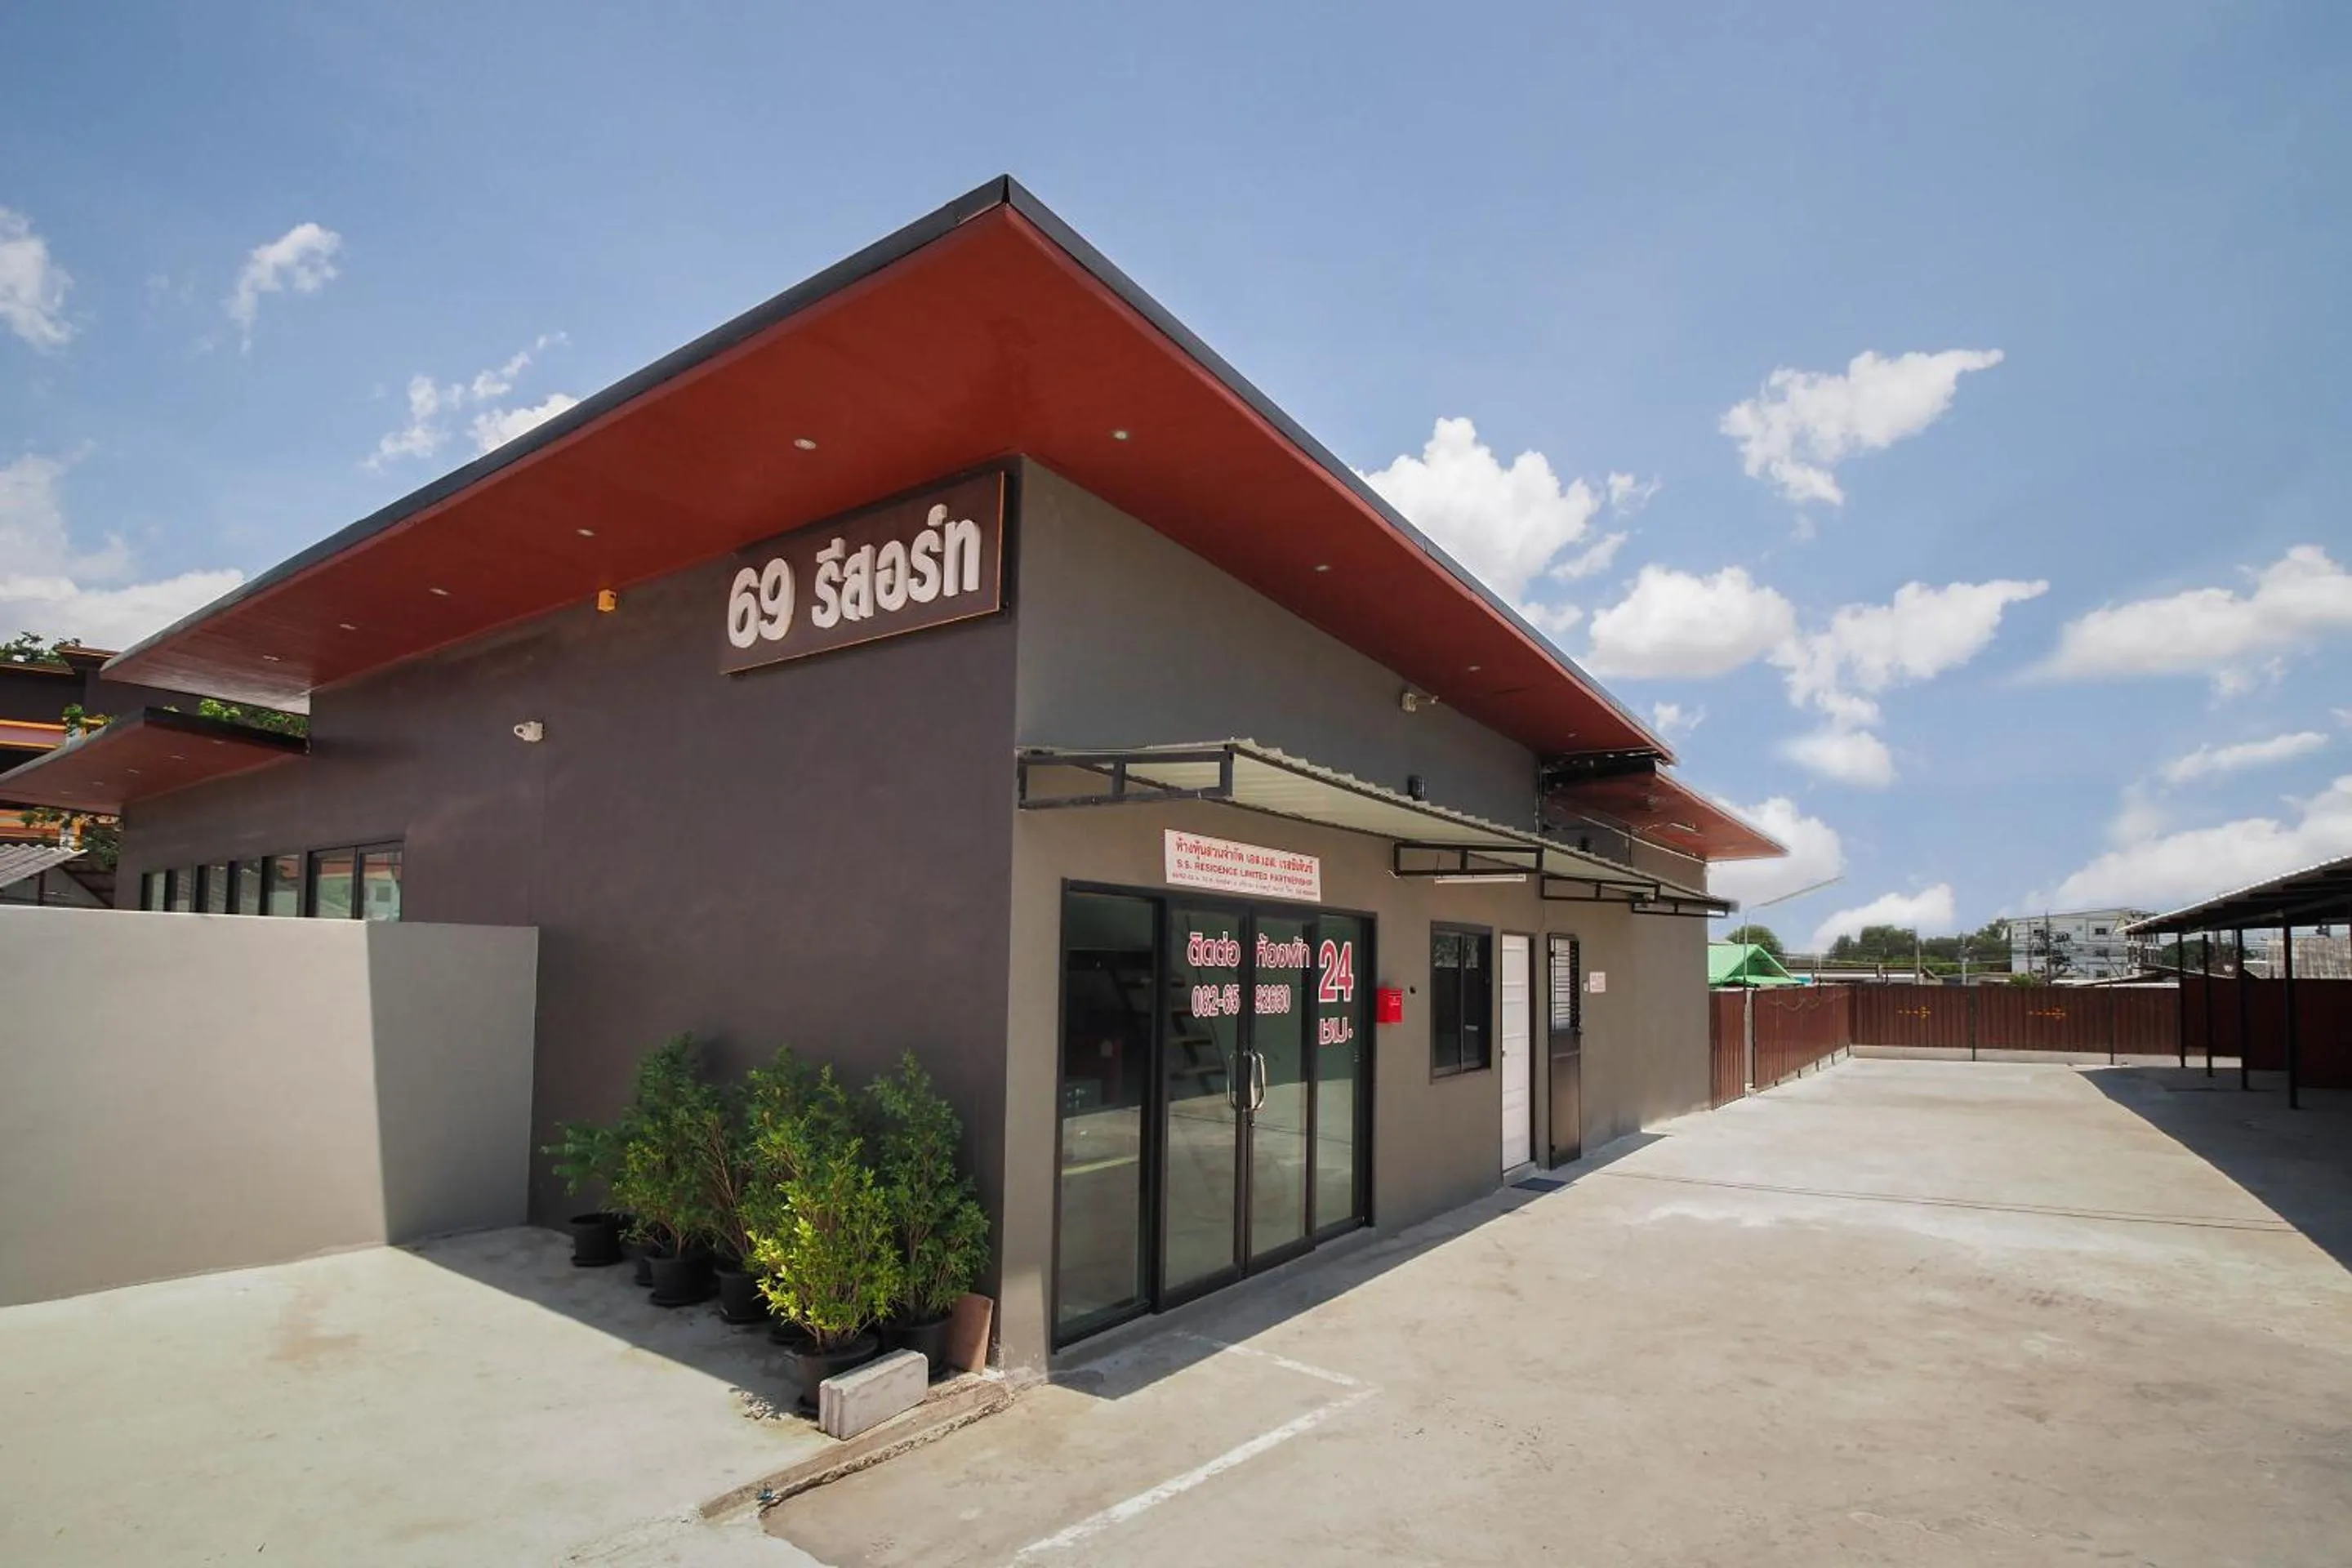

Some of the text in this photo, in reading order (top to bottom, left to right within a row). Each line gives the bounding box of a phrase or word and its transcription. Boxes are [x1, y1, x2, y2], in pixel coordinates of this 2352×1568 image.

[728, 503, 981, 648] 69 รีสอร์ท
[1194, 862, 1238, 876] RESIDENCE
[1240, 870, 1268, 880] LIMITED
[1269, 872, 1313, 886] PARTNERSHIP
[1187, 931, 1311, 968] ติดต่อ ห้องพัก
[1318, 939, 1354, 1002] 24
[1318, 1017, 1354, 1045] ชม.
